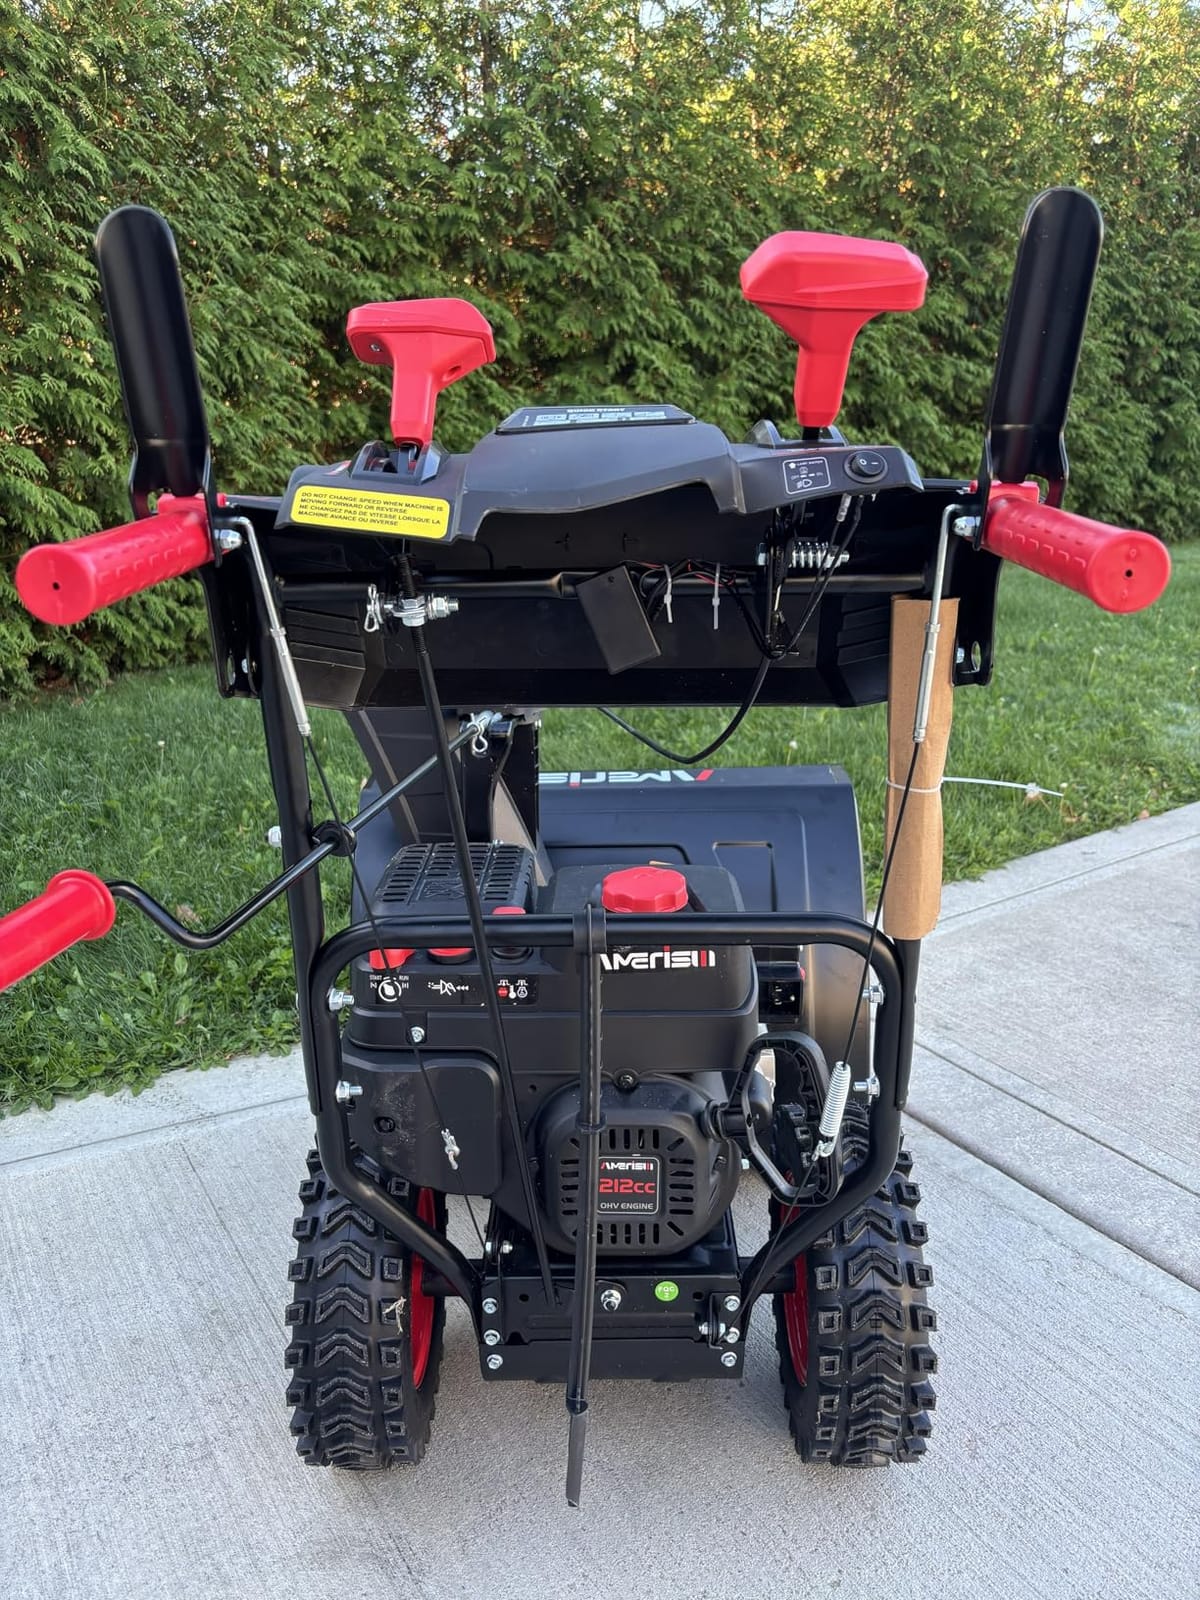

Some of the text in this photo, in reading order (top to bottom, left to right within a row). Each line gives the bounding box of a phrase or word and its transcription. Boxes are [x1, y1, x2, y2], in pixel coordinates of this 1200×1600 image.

[328, 494, 358, 502] CHANGE
[359, 497, 382, 505] SPEED
[404, 502, 436, 511] MACHINE
[328, 501, 363, 509] FORWARD
[376, 506, 408, 514] REVERSE
[298, 510, 329, 518] MACHINE
[329, 513, 357, 522] AVANCE
[369, 518, 399, 526] INVERSE
[310, 505, 343, 514] CHANGEZ
[344, 508, 358, 516] PAS
[369, 512, 397, 520] VITESSE
[398, 515, 431, 524] LORSQUE
[599, 1178, 656, 1194] 212cc
[620, 1202, 654, 1210] ENGINE
